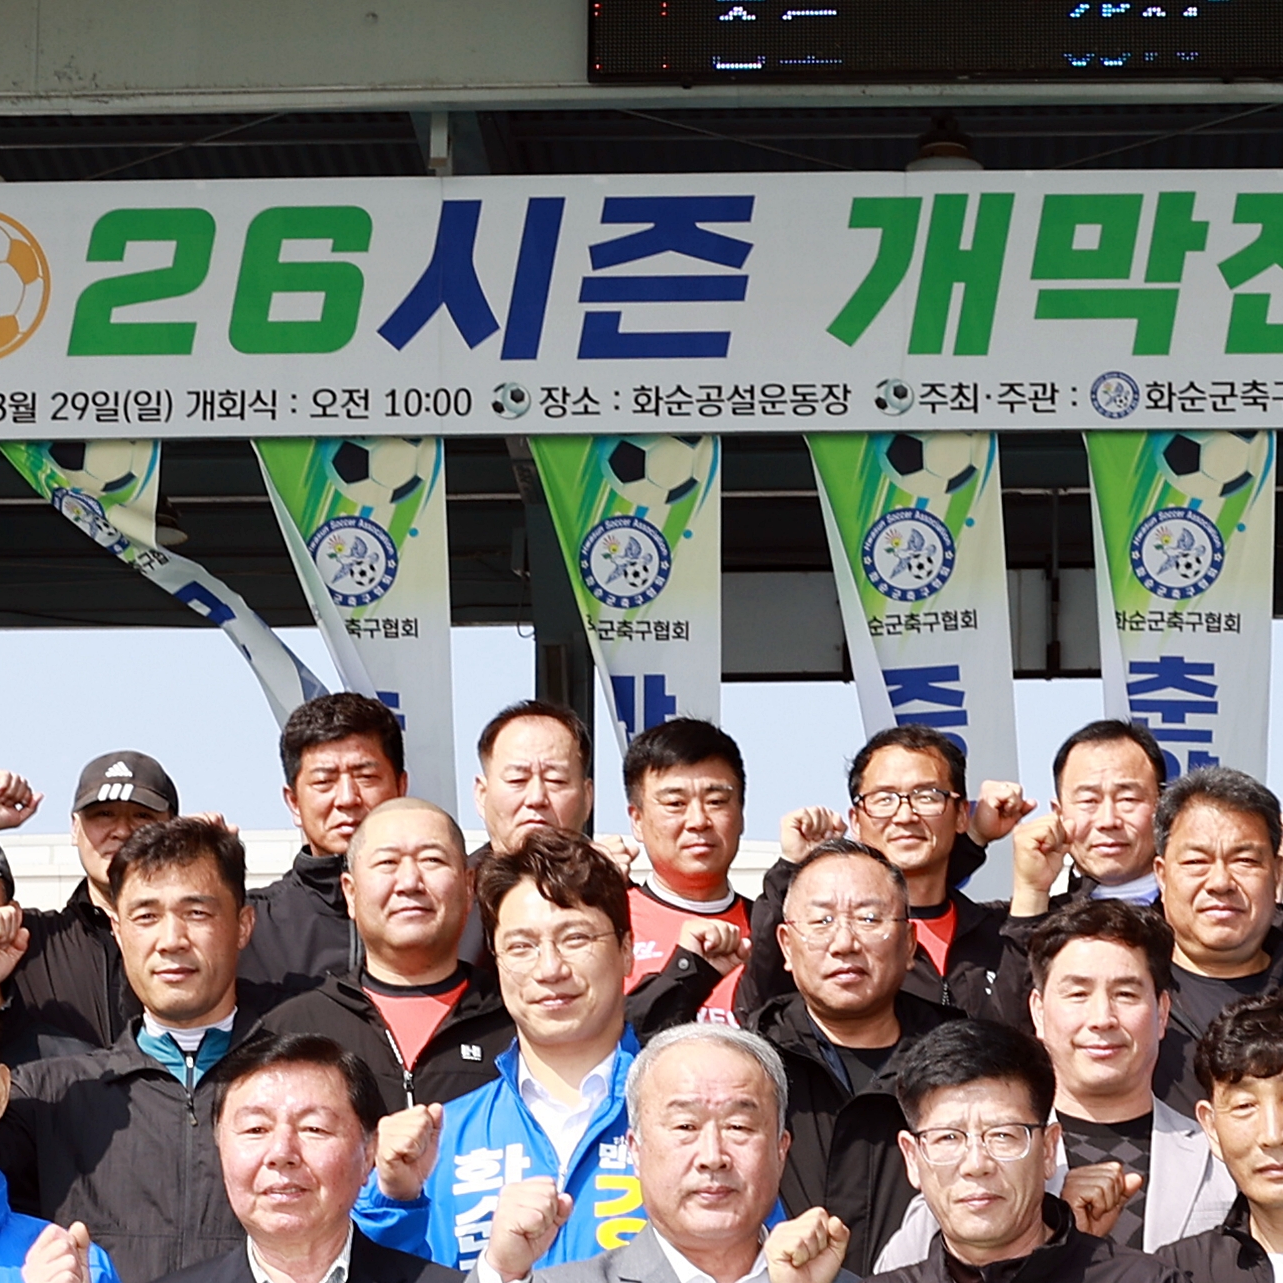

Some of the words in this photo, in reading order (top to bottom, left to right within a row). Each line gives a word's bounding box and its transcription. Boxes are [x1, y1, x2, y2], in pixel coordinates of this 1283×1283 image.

[49, 388, 174, 424] 29일(일)
[185, 388, 278, 422] 개회식
[309, 388, 370, 421] 오전
[384, 387, 473, 419] 10:00
[538, 386, 602, 420] 장소
[631, 383, 852, 418] 화순공설운동장
